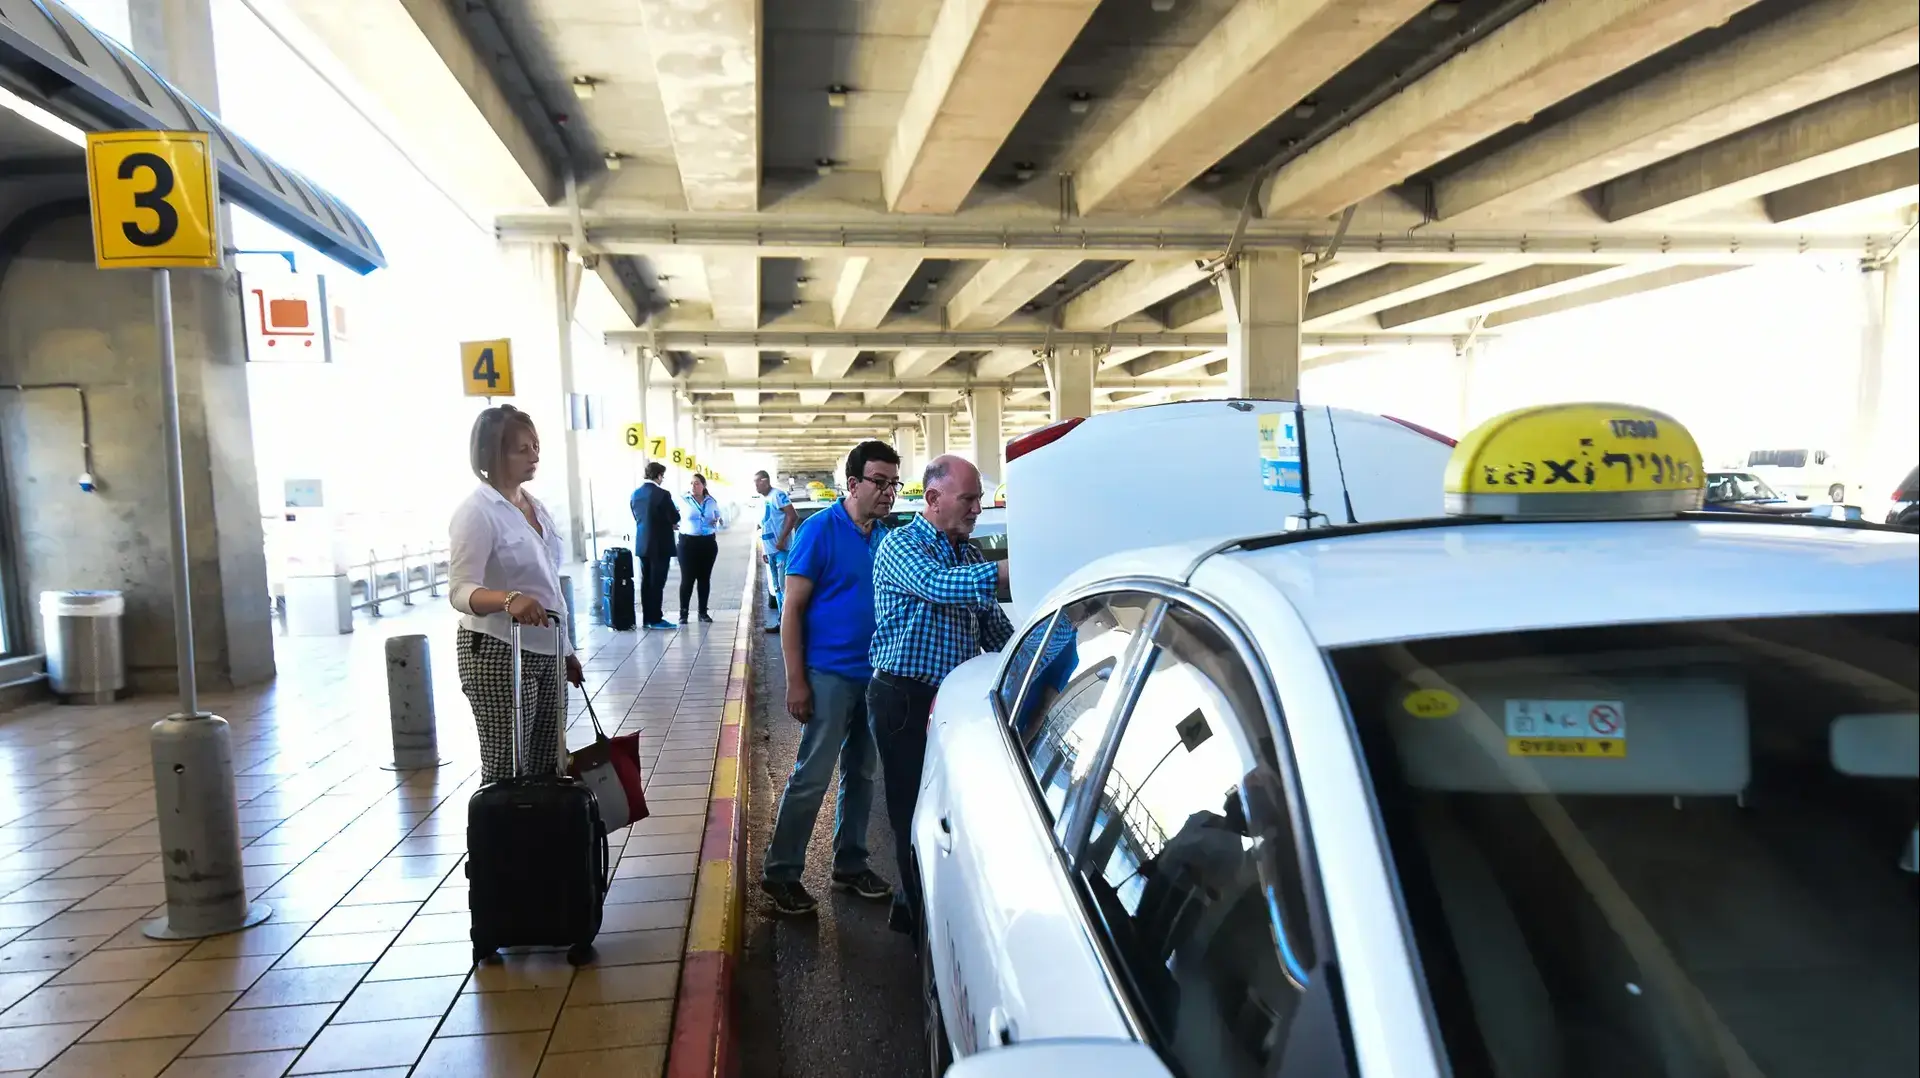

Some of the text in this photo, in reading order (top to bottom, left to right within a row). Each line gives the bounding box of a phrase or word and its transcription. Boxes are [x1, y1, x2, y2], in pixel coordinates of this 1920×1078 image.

[117, 152, 179, 247] 3
[472, 348, 500, 388] 4
[626, 427, 638, 446] 6
[651, 440, 661, 455] 7
[673, 450, 681, 463] 8
[686, 457, 692, 469] 9
[1484, 438, 1595, 484] taxi
